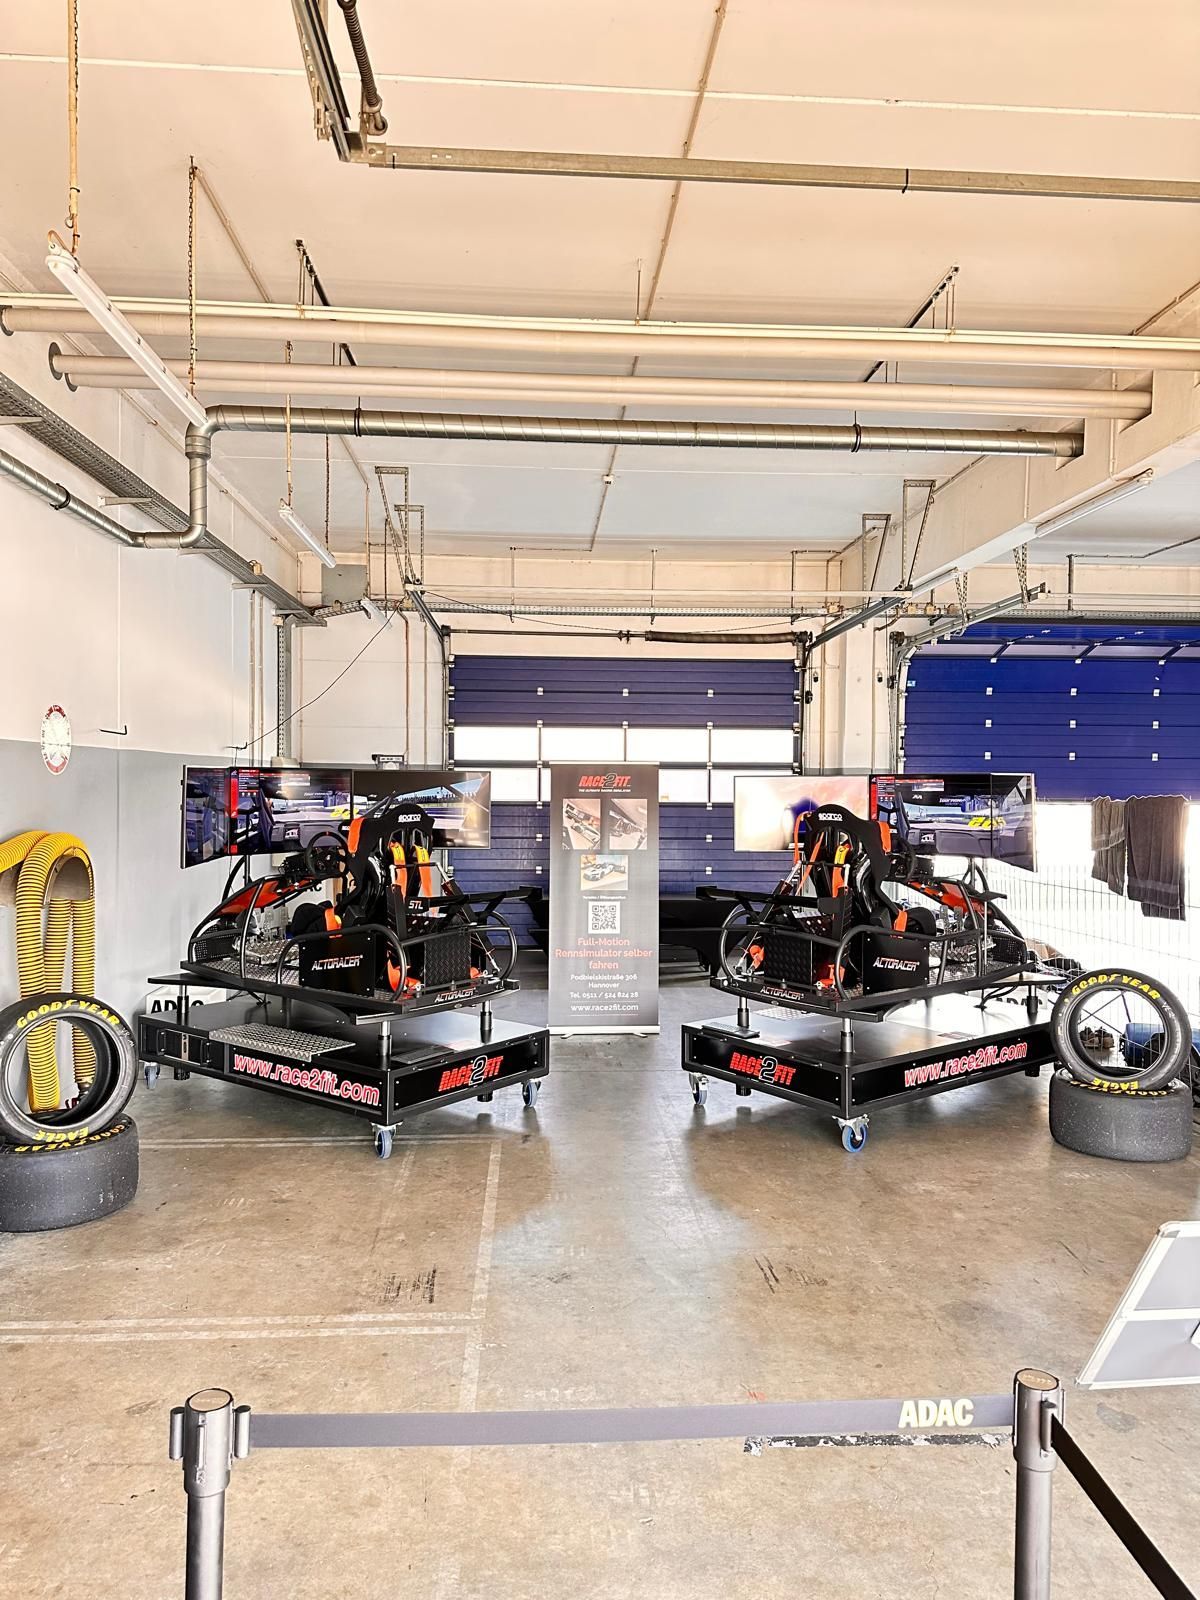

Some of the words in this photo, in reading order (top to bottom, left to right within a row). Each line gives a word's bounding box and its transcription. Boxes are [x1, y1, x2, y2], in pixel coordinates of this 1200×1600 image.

[579, 773, 631, 788] RACE2FIT
[408, 900, 424, 910] STL
[577, 937, 630, 946] Full-Motion
[555, 949, 621, 958] Rennsimulator
[623, 948, 653, 958] selber
[589, 960, 619, 969] fahren
[588, 981, 621, 989] Hannover
[570, 1003, 639, 1011] www.race2fit.com
[729, 1052, 796, 1086] RACE2FIT
[904, 1042, 1028, 1087] www.race2fit.com
[233, 1053, 380, 1106] www.race2fit.com
[438, 1055, 504, 1092] RACE2FIT
[1091, 1078, 1139, 1091] EAGLE
[32, 1126, 89, 1143] EAGLE
[898, 1398, 975, 1428] ADAC
